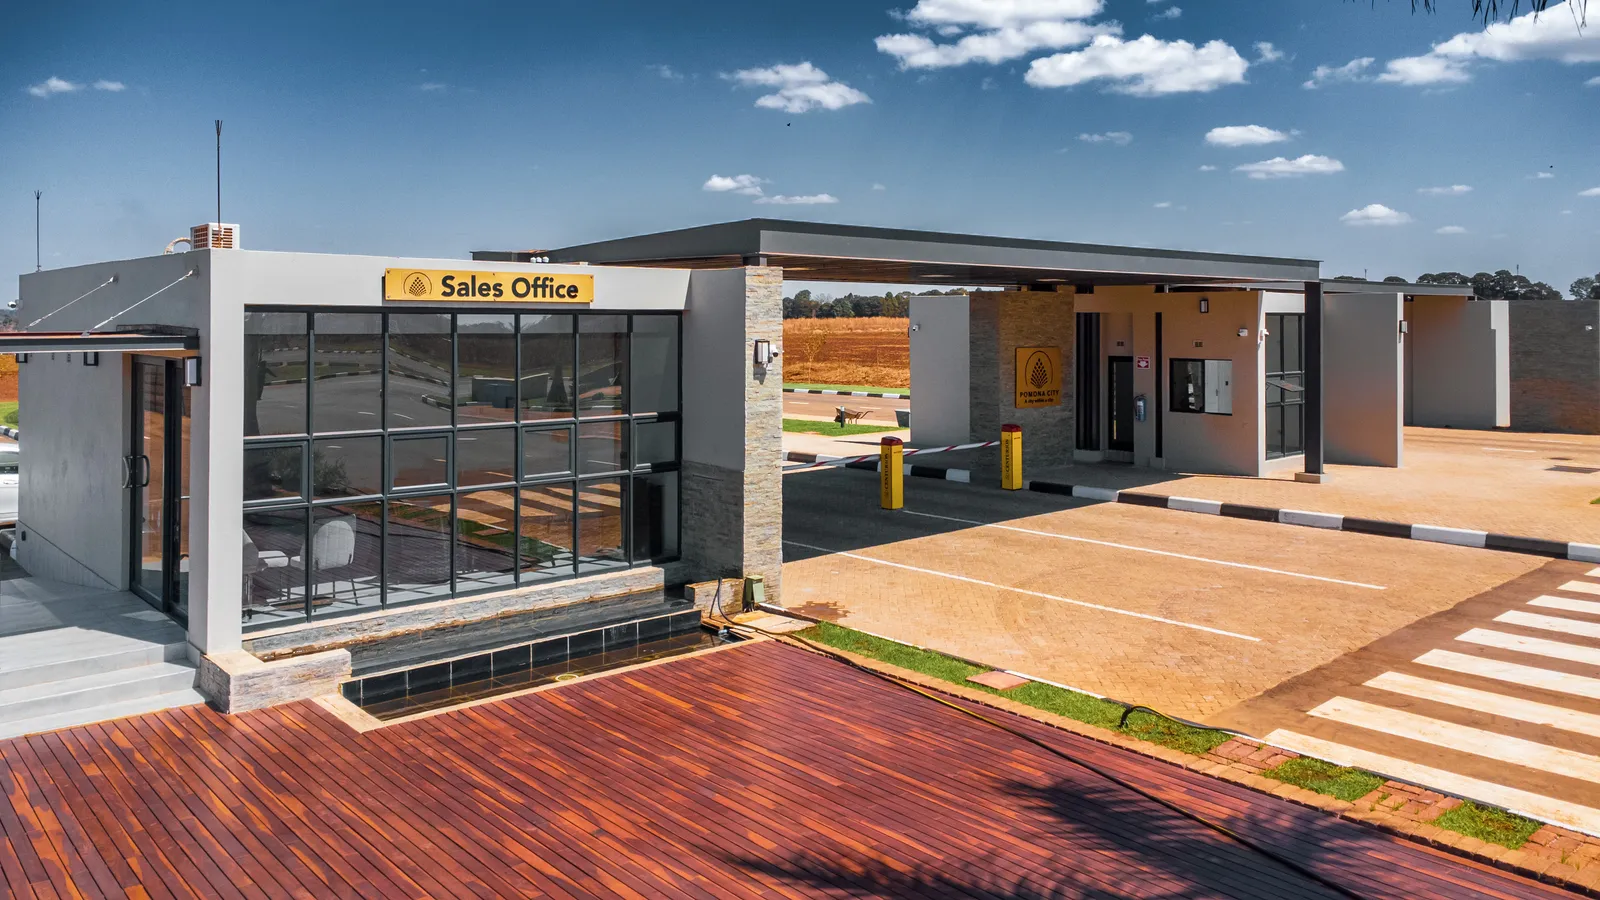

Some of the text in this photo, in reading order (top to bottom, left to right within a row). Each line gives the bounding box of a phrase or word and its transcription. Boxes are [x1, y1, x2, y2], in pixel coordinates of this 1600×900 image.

[441, 275, 579, 299] Sales Office
[1046, 389, 1060, 397] CITY
